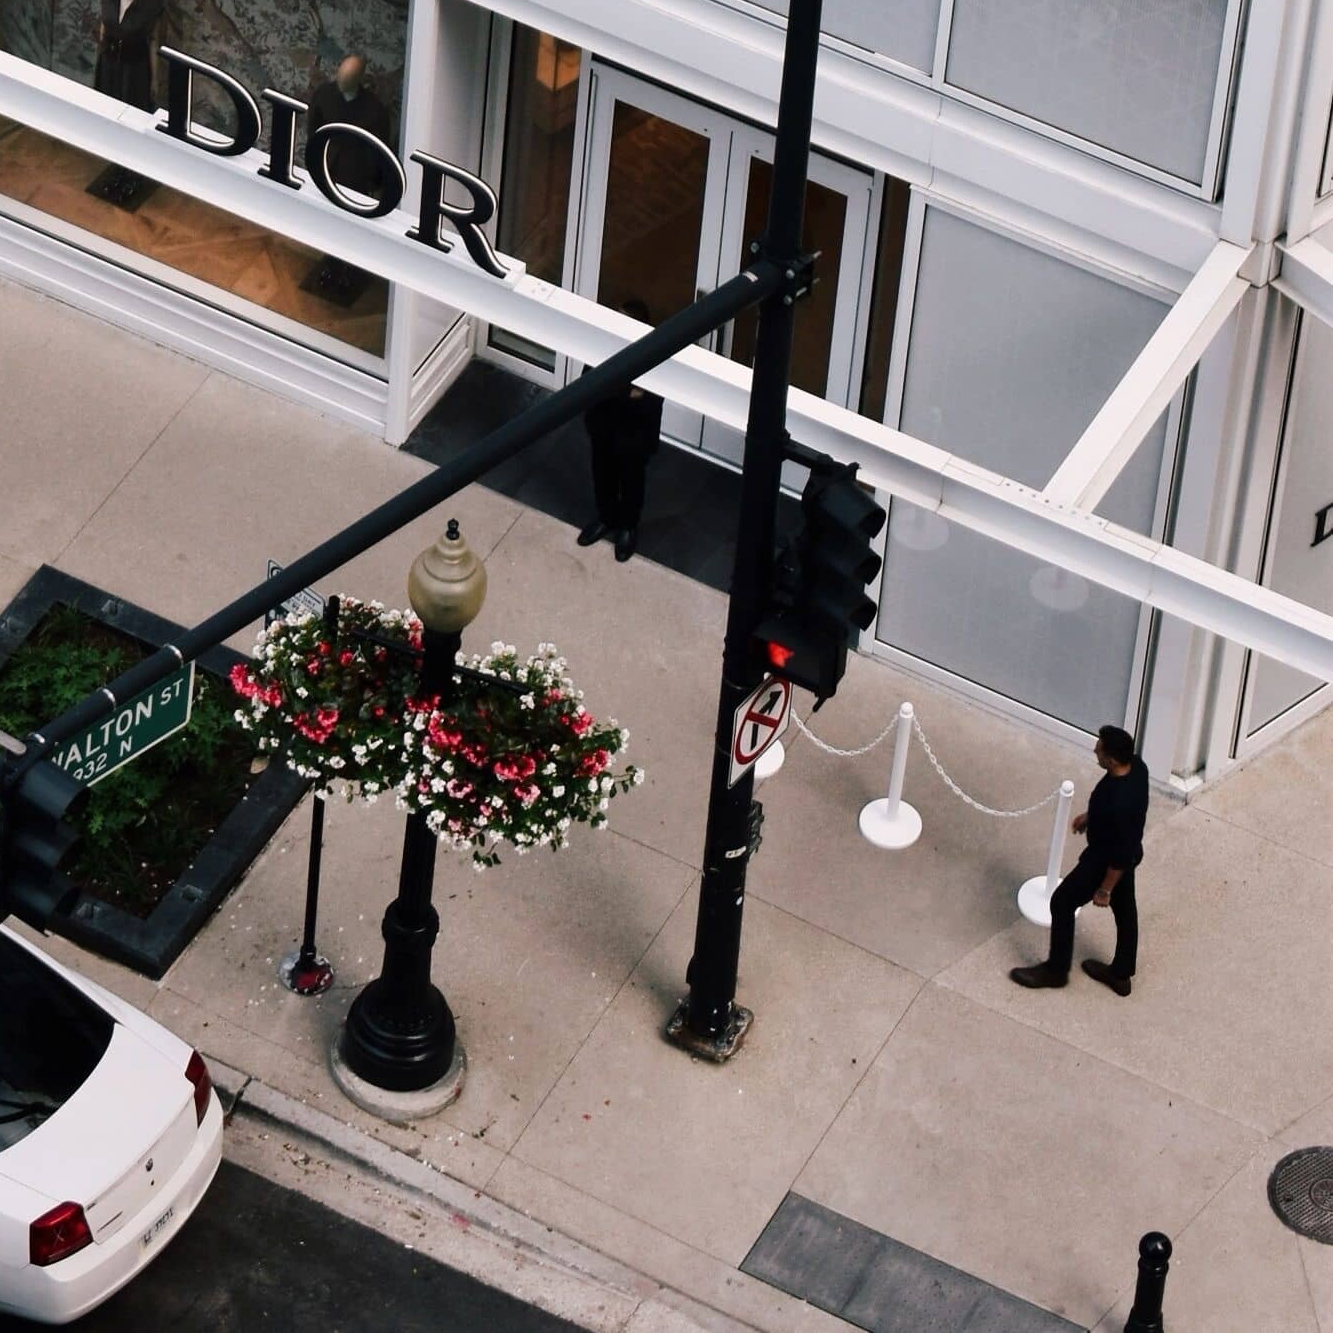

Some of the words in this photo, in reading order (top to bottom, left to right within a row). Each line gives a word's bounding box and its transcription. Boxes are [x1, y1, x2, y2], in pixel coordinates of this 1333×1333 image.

[155, 45, 511, 279] DIOR
[160, 678, 184, 705] ST
[119, 735, 132, 757] N
